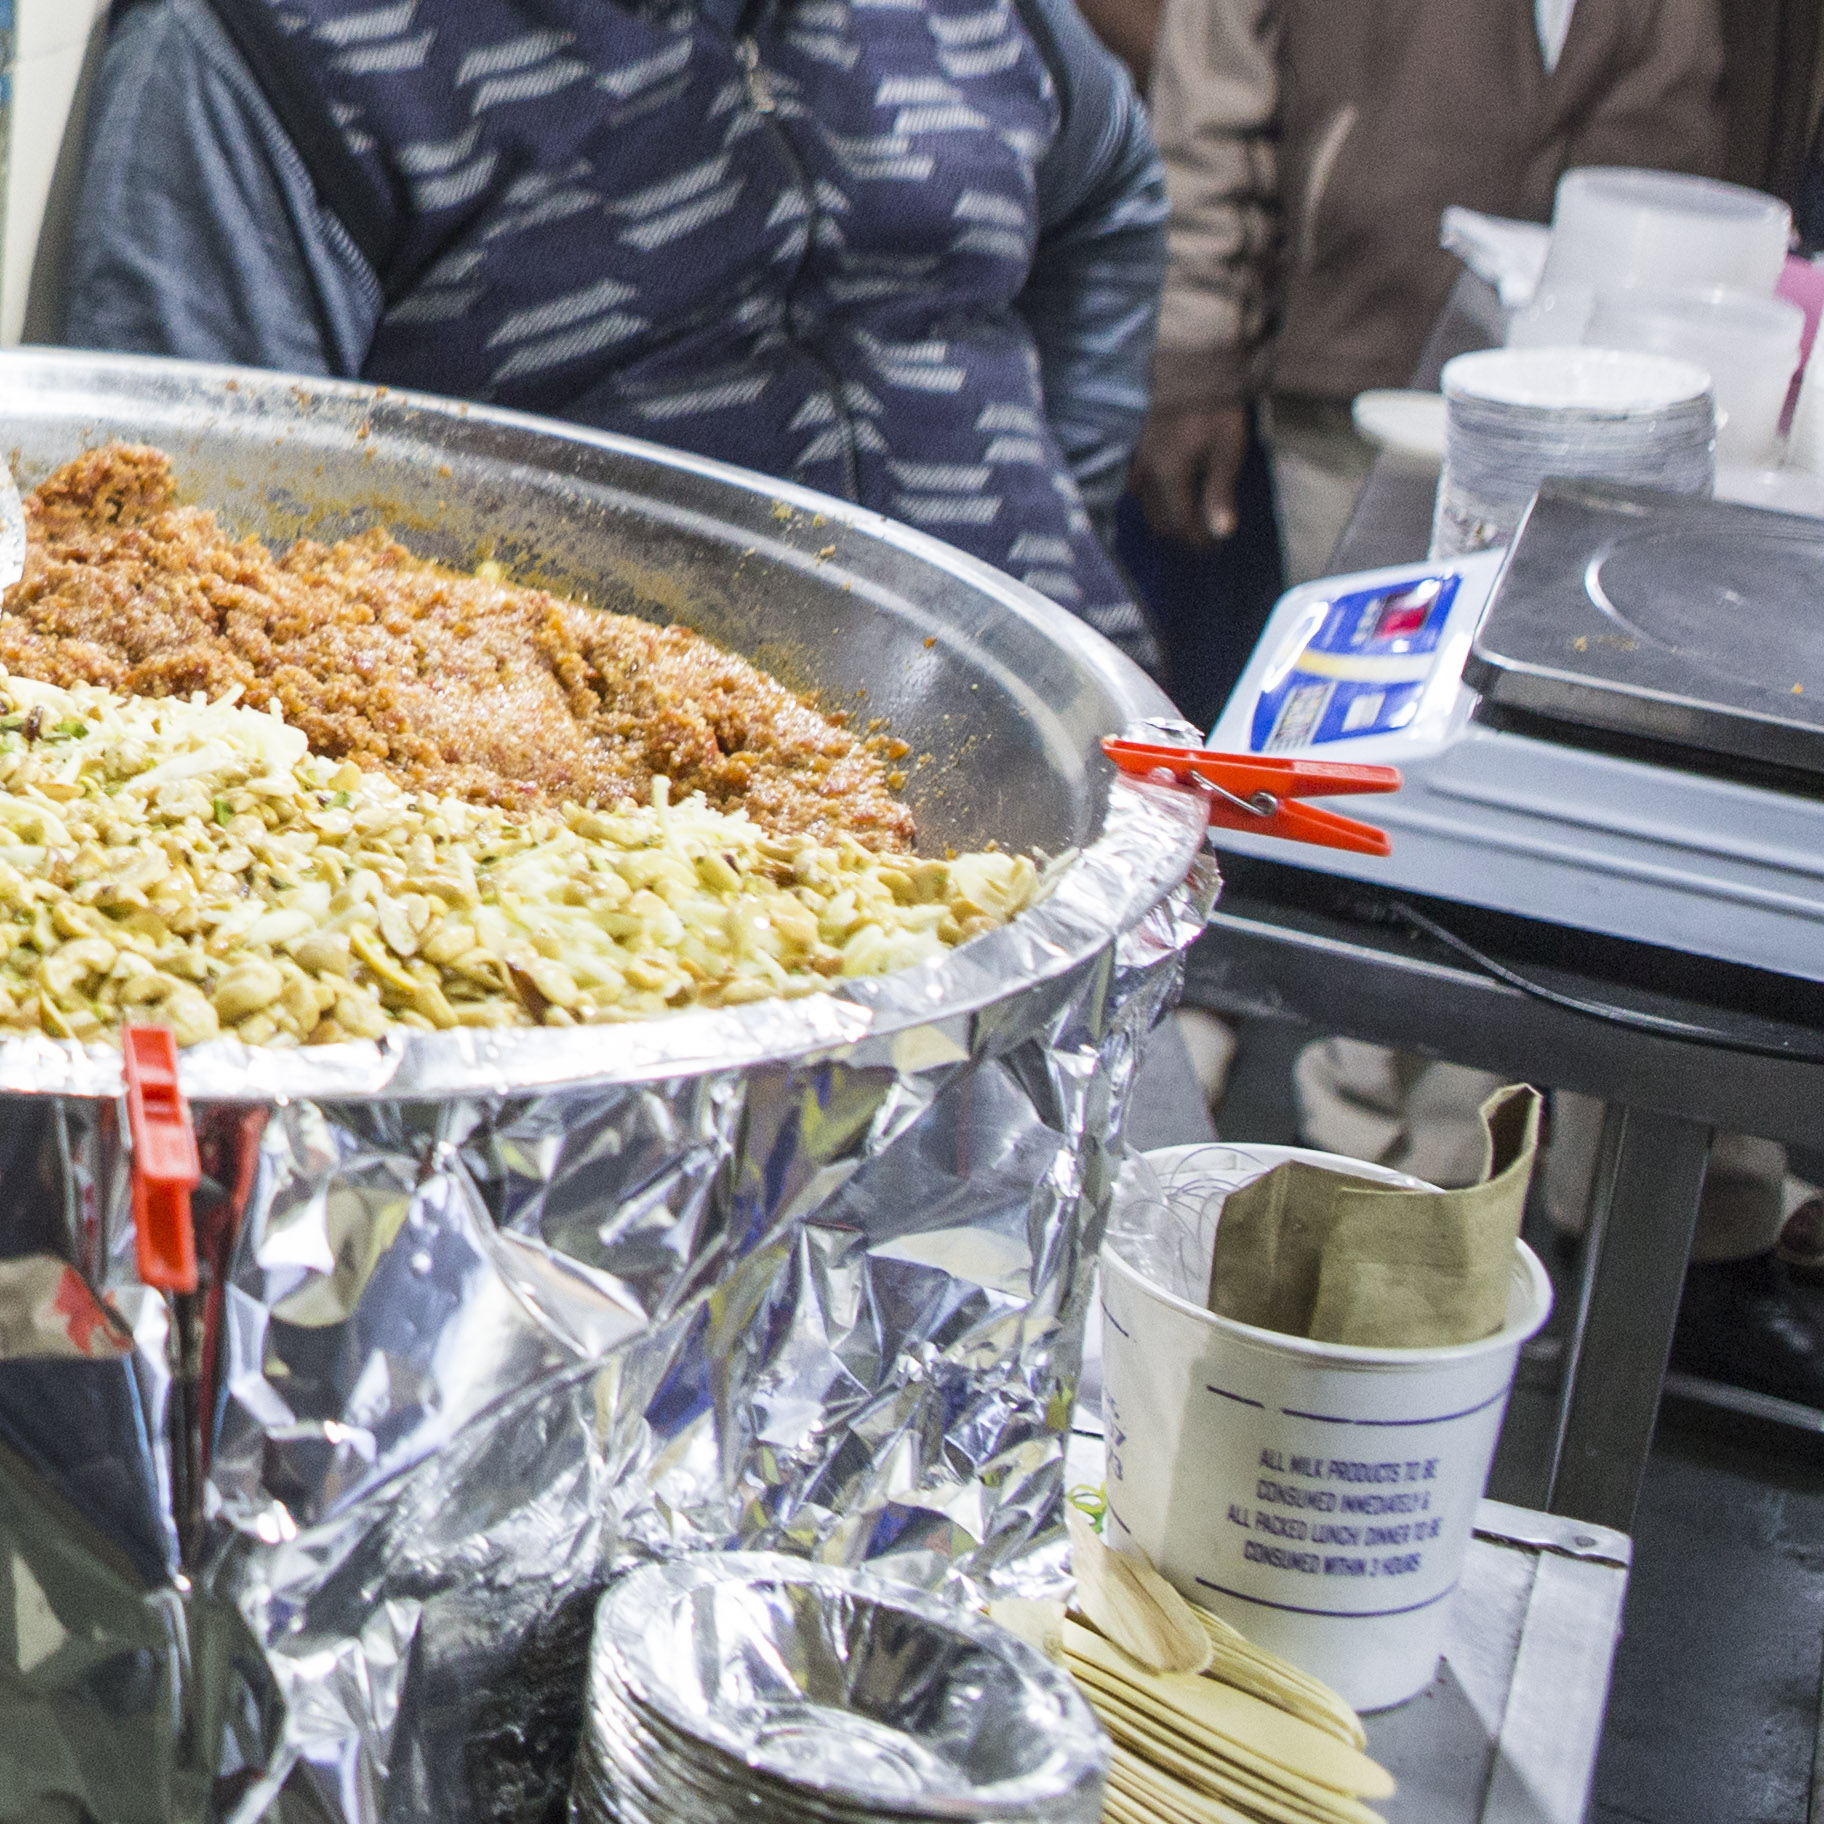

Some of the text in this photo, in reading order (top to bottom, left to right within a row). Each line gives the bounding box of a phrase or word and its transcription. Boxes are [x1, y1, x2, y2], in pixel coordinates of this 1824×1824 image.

[1258, 1446, 1440, 1484] ALL MILK PRODUCTS TO BE
[1255, 1478, 1336, 1512] CONSUMED
[1227, 1503, 1444, 1546] ALL PACKED LUNCH DINNER TO BE
[1244, 1539, 1320, 1574] CONSUMED
[1382, 1551, 1421, 1575] HOURS
